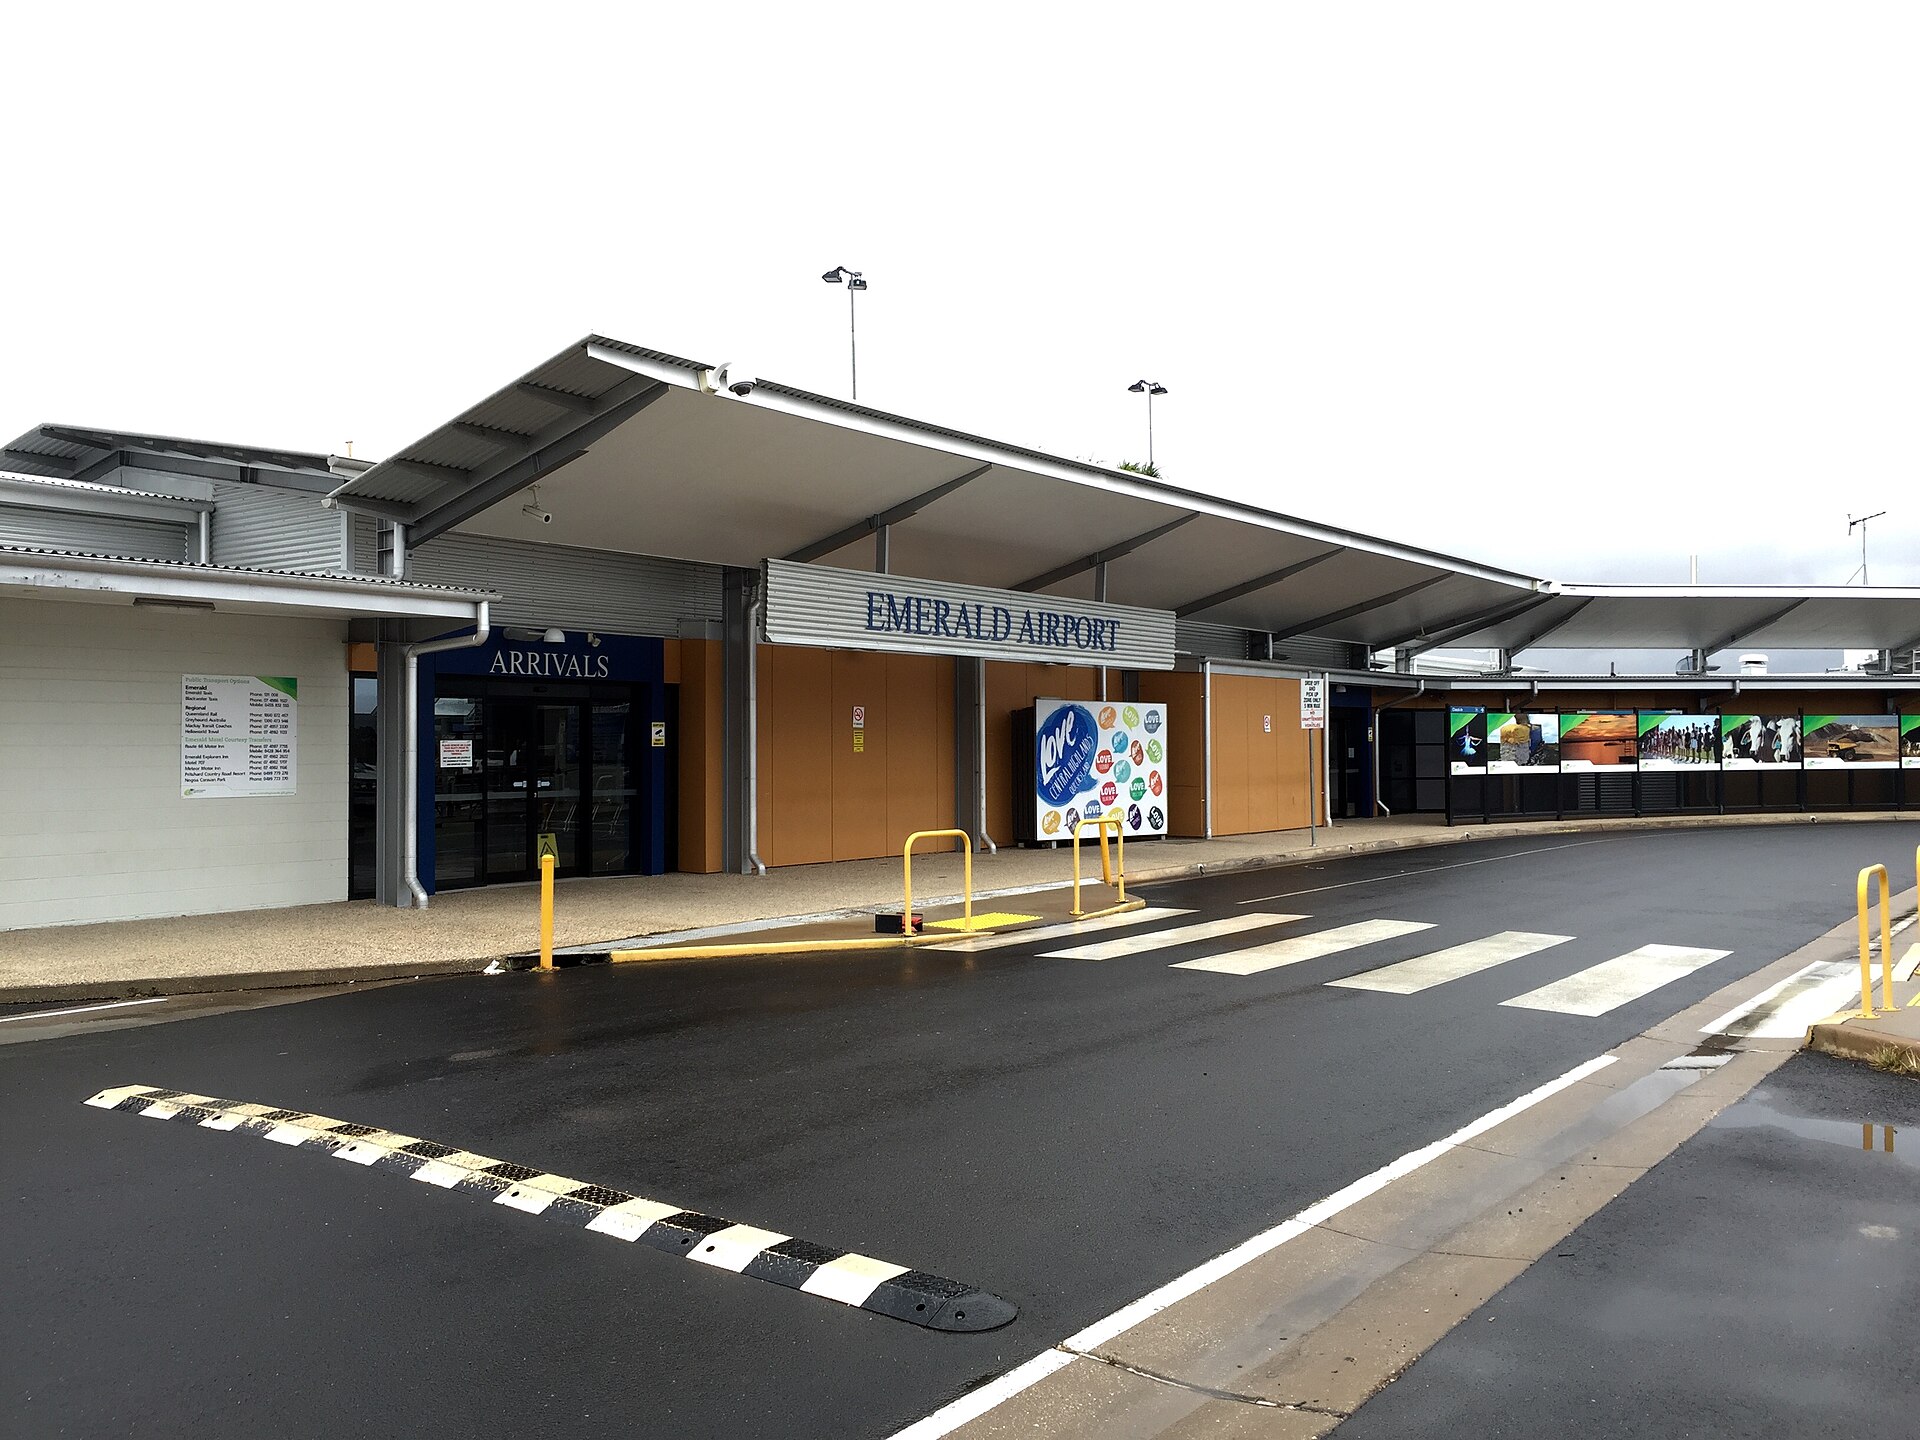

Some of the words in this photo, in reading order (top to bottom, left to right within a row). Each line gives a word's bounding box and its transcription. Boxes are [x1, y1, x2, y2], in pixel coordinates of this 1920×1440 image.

[865, 592, 1010, 642] EMERALD
[1017, 609, 1120, 651] AIRPORT
[490, 650, 608, 678] ARRIVALS
[1049, 766, 1073, 800] CENTRAL
[1068, 736, 1094, 775] HIGHLANDS
[1097, 755, 1111, 763] LOVE
[1069, 762, 1090, 794] QUEENSLAND
[1101, 787, 1115, 795] LOVE
[1085, 806, 1100, 814] LOVE
[1151, 807, 1163, 827] LOVE
